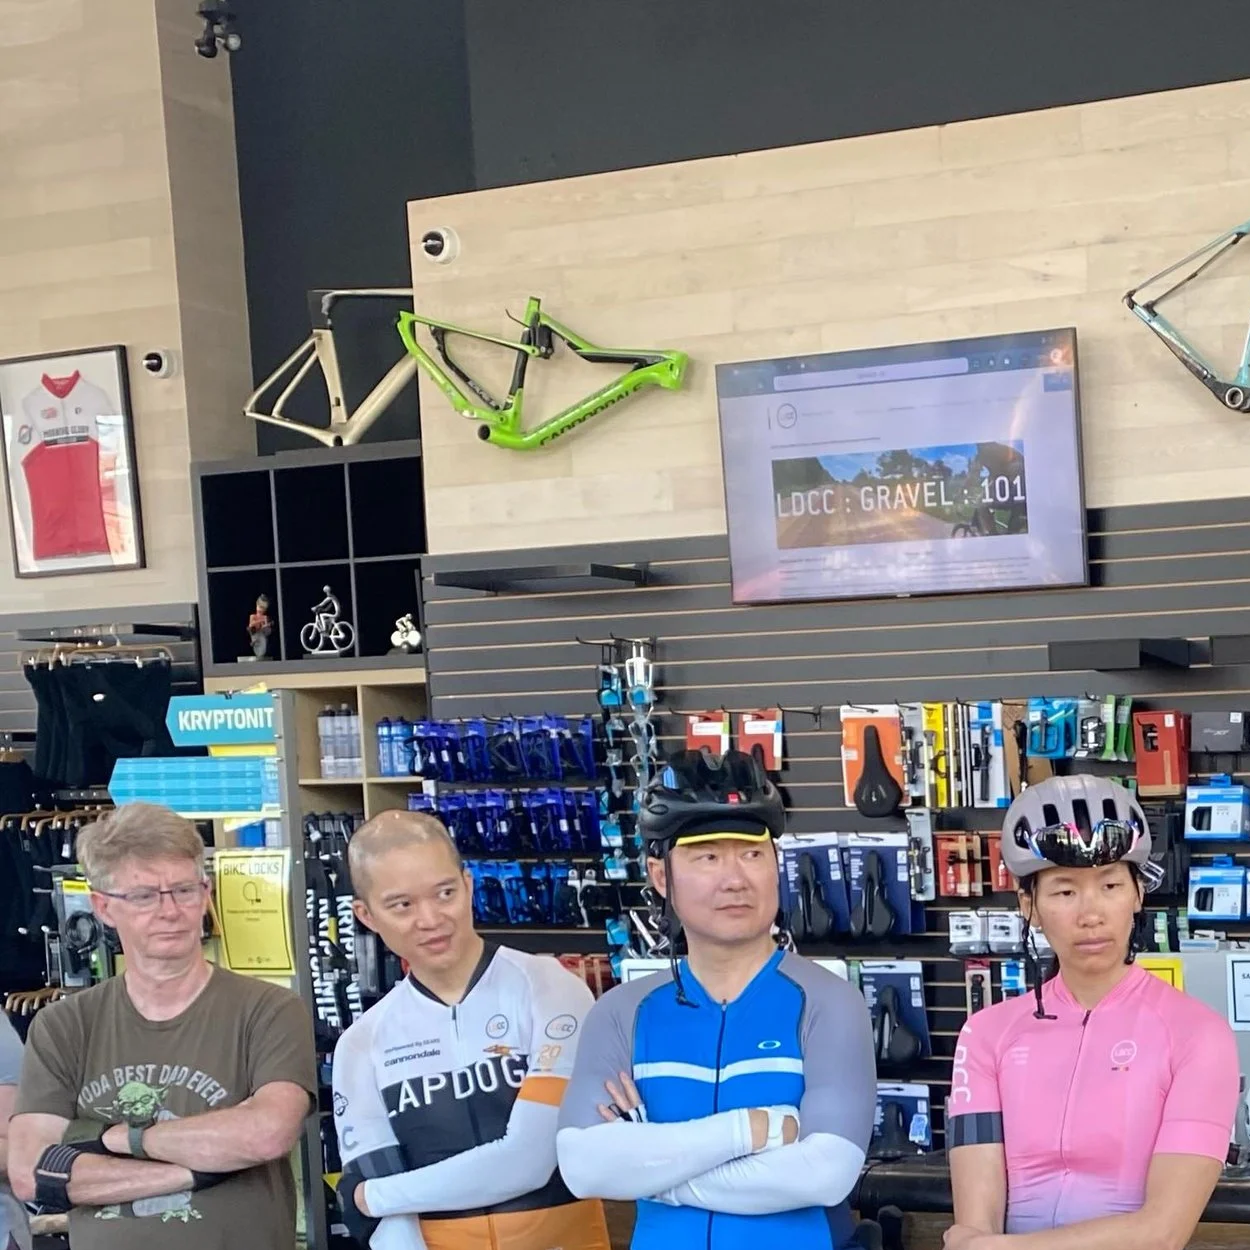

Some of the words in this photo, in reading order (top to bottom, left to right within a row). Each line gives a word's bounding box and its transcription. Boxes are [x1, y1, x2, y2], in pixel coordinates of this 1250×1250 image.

[776, 488, 836, 518] LDCC
[860, 480, 954, 512] GRAVEL
[980, 474, 1026, 504] 101
[178, 706, 275, 732] KRYPTONIT
[223, 863, 247, 876] BIKE
[249, 861, 280, 875] LOCKS
[383, 1048, 441, 1068] cannondale
[113, 1064, 157, 1088] BEST
[159, 1064, 190, 1086] DAD
[186, 1070, 229, 1107] EVER
